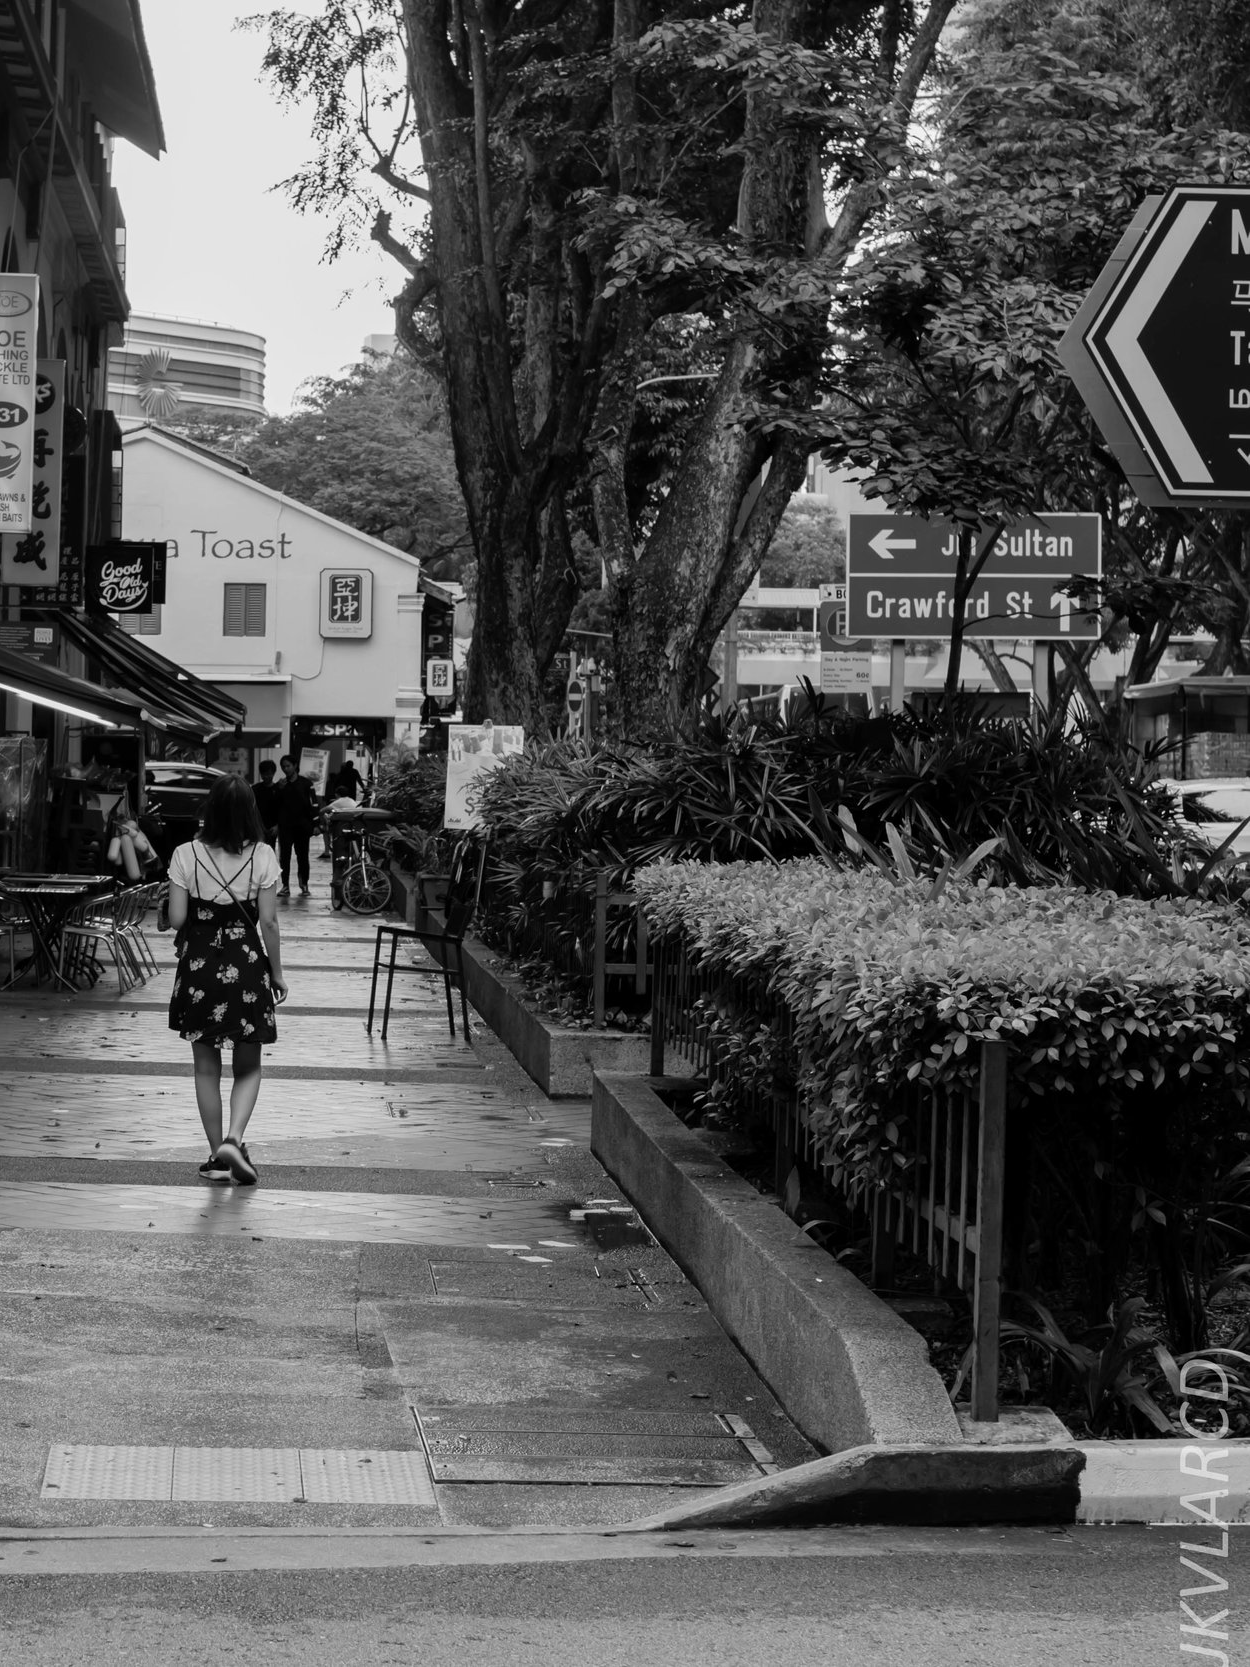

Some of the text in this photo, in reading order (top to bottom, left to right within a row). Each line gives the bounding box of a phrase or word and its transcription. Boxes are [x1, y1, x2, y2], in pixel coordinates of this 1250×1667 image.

[12, 374, 30, 385] LTD
[20, 493, 26, 502] &
[1, 513, 23, 523] BAITS
[190, 530, 292, 560] Toast
[993, 529, 1073, 557] Sultan
[99, 557, 143, 587] Good
[119, 574, 142, 589] Old
[102, 584, 142, 603] Days
[1006, 591, 1033, 619] St
